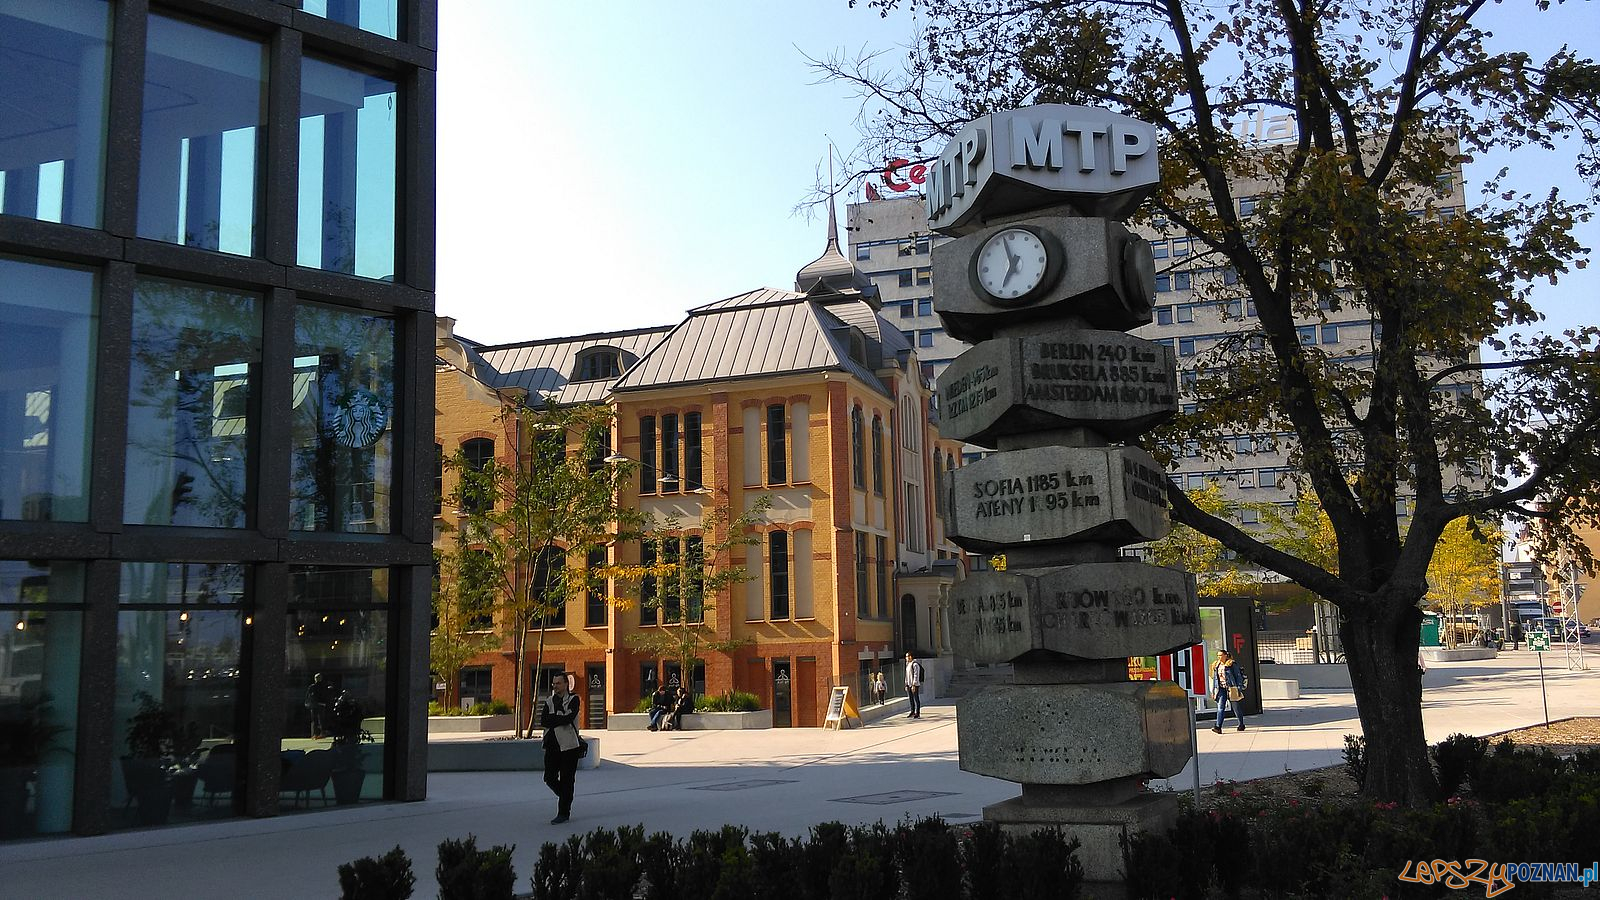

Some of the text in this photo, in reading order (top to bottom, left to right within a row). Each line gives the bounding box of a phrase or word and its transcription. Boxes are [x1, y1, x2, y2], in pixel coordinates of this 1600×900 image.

[1009, 116, 1150, 175] MTP
[926, 129, 987, 221] MTP
[1039, 343, 1156, 362] BERLIN 240 km
[1030, 363, 1108, 383] BRUKSELA
[1025, 384, 1118, 403] AMSTERDAM
[973, 470, 1094, 499] SOFIA 1185 km
[975, 490, 1100, 520] ATENY 195 km
